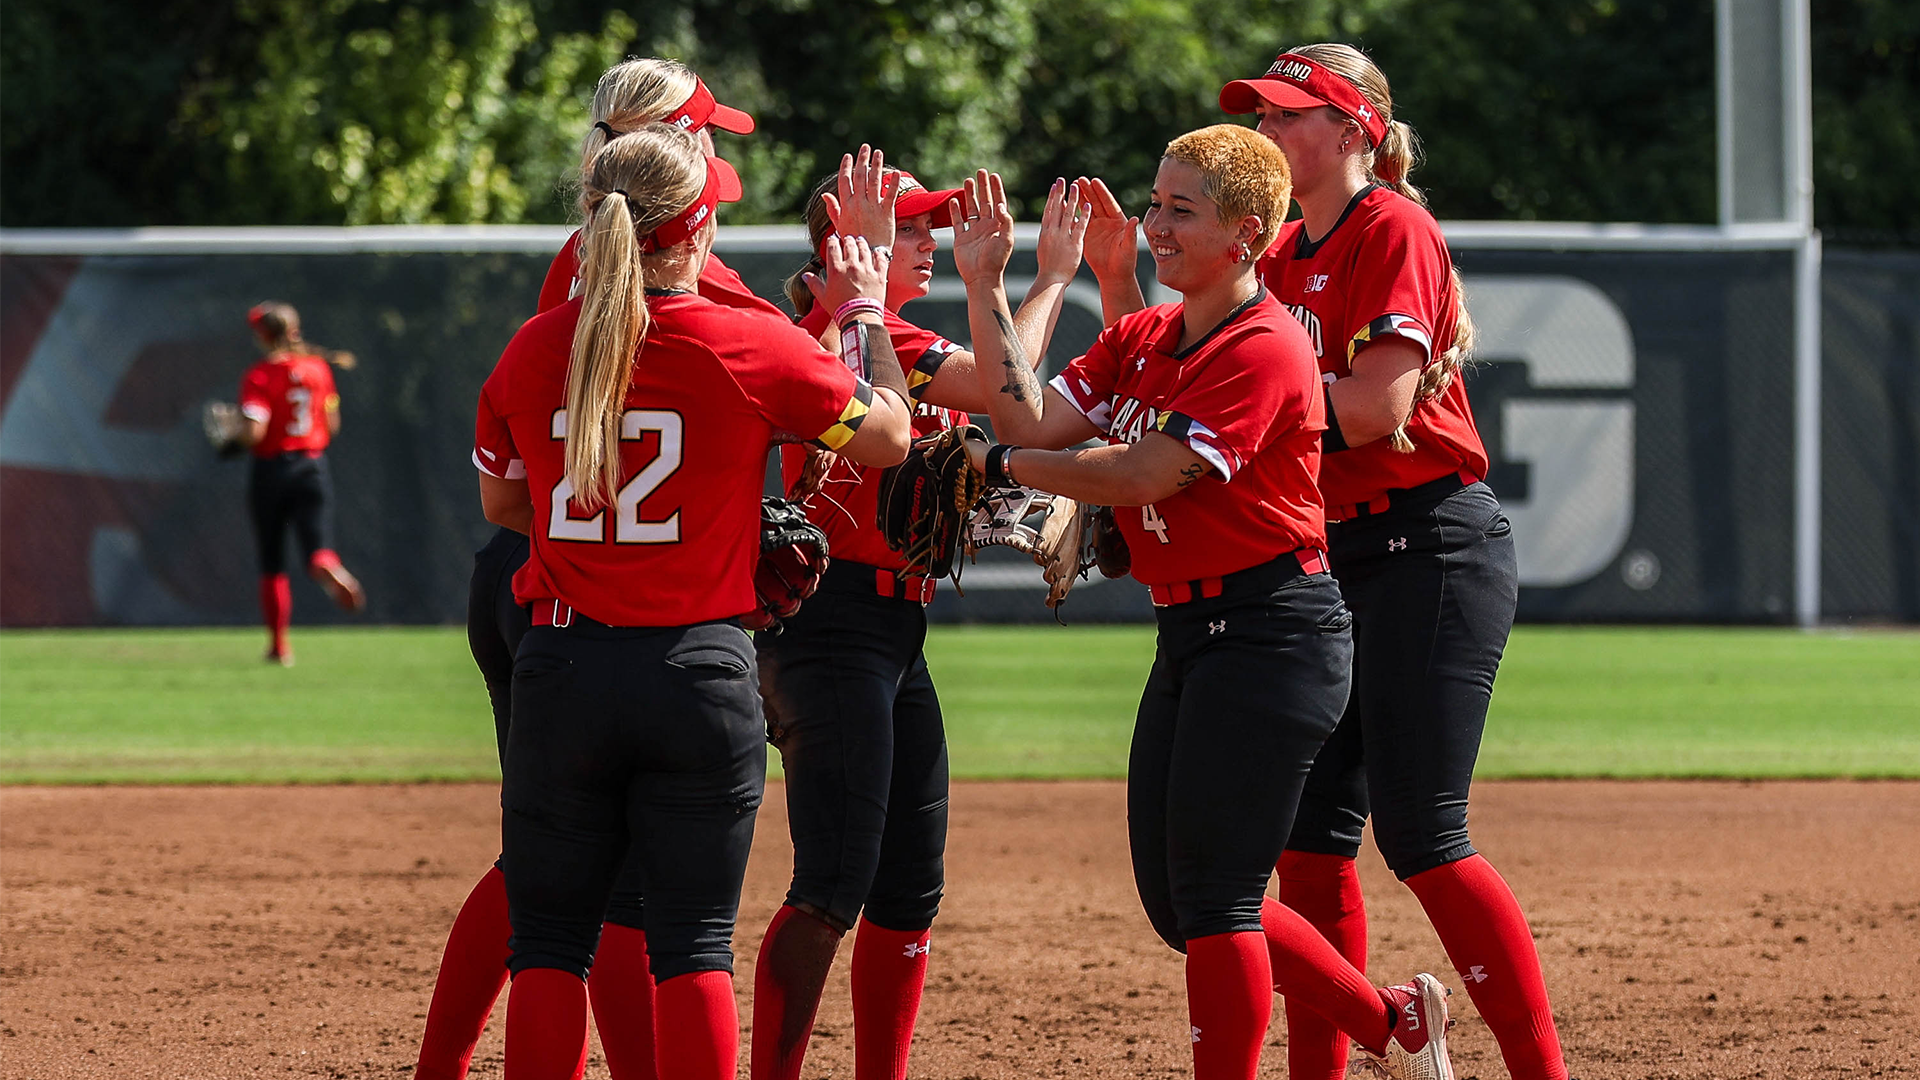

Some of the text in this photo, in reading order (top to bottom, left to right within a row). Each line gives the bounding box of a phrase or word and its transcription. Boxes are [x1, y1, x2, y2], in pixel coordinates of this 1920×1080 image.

[285, 386, 313, 437] 3
[549, 408, 684, 544] 22
[1141, 503, 1170, 544] 4
[1404, 1000, 1420, 1031] UA
